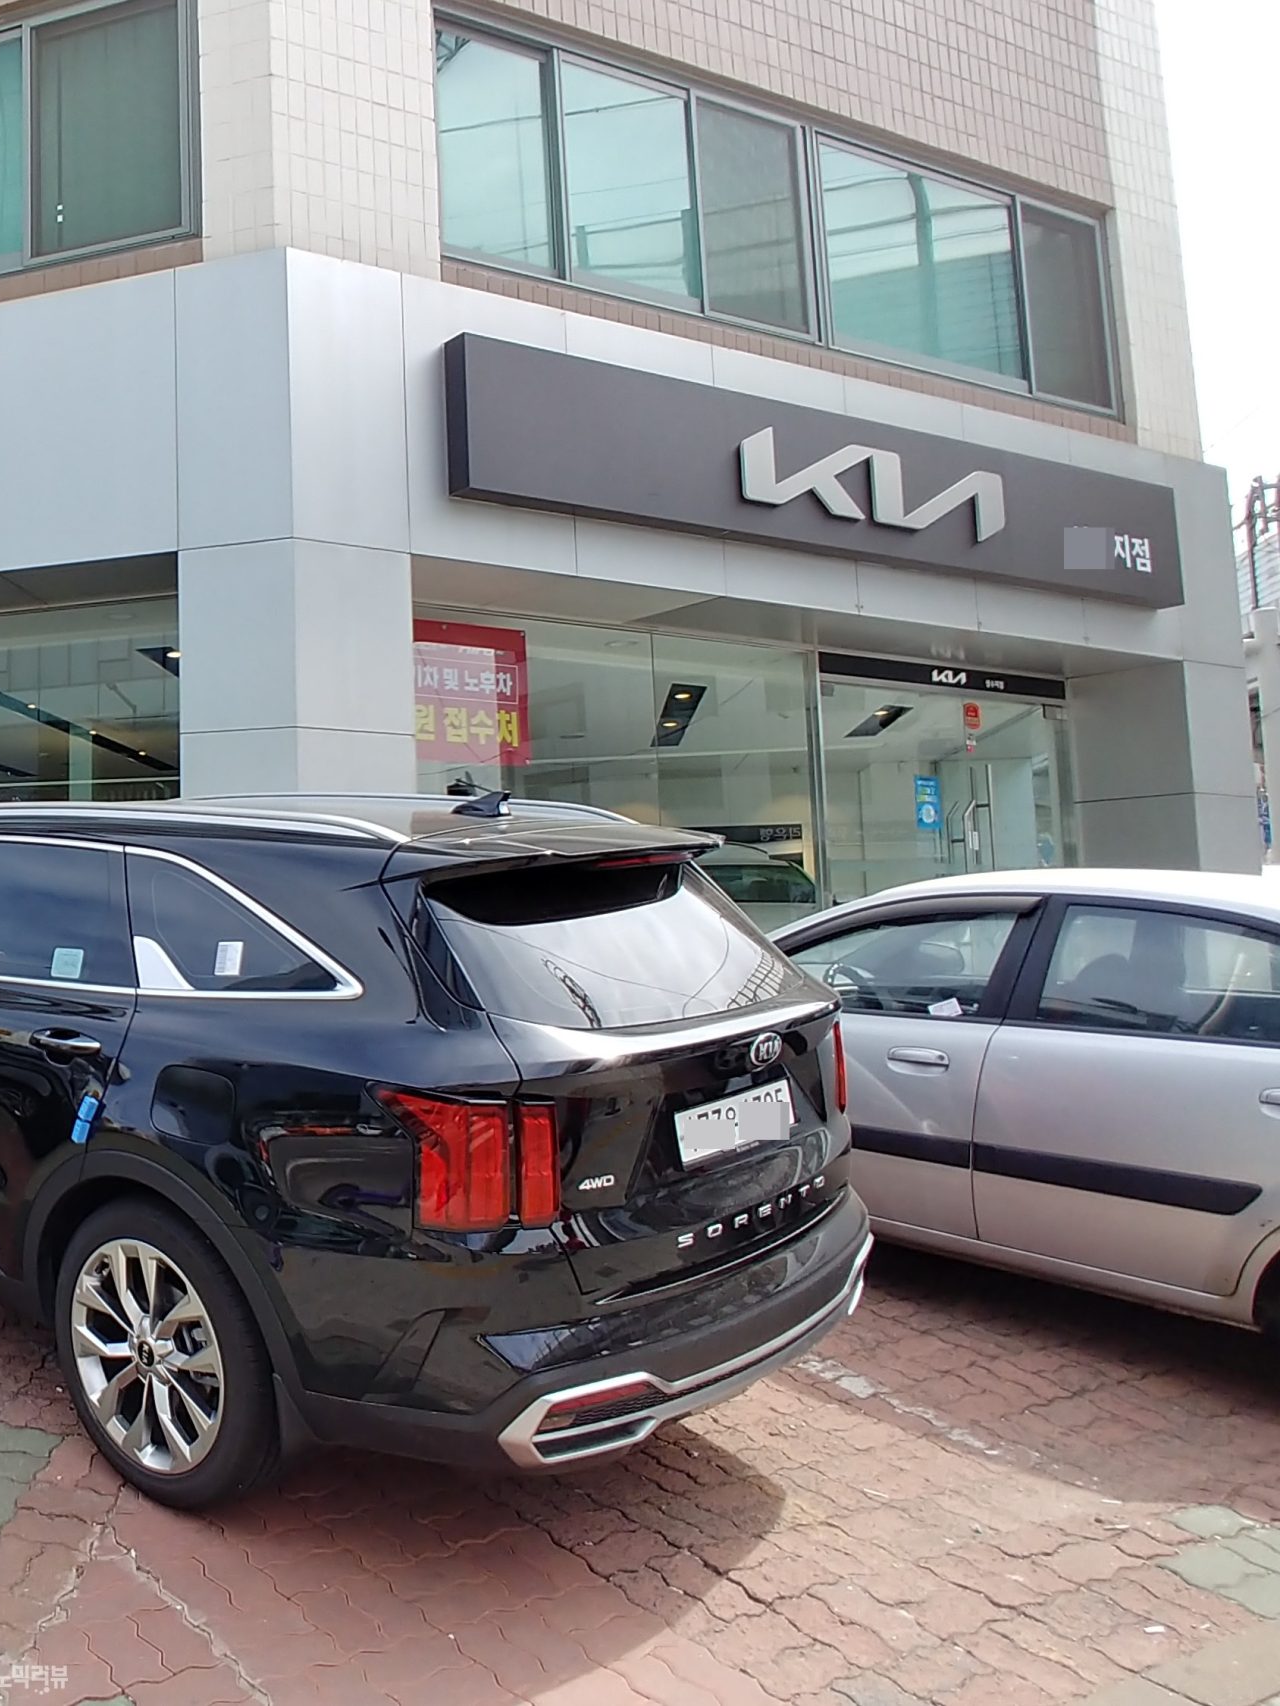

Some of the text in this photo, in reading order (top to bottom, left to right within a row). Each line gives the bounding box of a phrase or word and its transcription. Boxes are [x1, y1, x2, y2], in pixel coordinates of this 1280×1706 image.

[740, 425, 1006, 543] KIA
[442, 668, 460, 691] 및
[463, 668, 514, 697] 노후차
[442, 706, 520, 748] 접수처
[757, 1037, 782, 1062] KIA
[578, 1174, 615, 1191] 4WD
[677, 1175, 826, 1248] SORENTO
